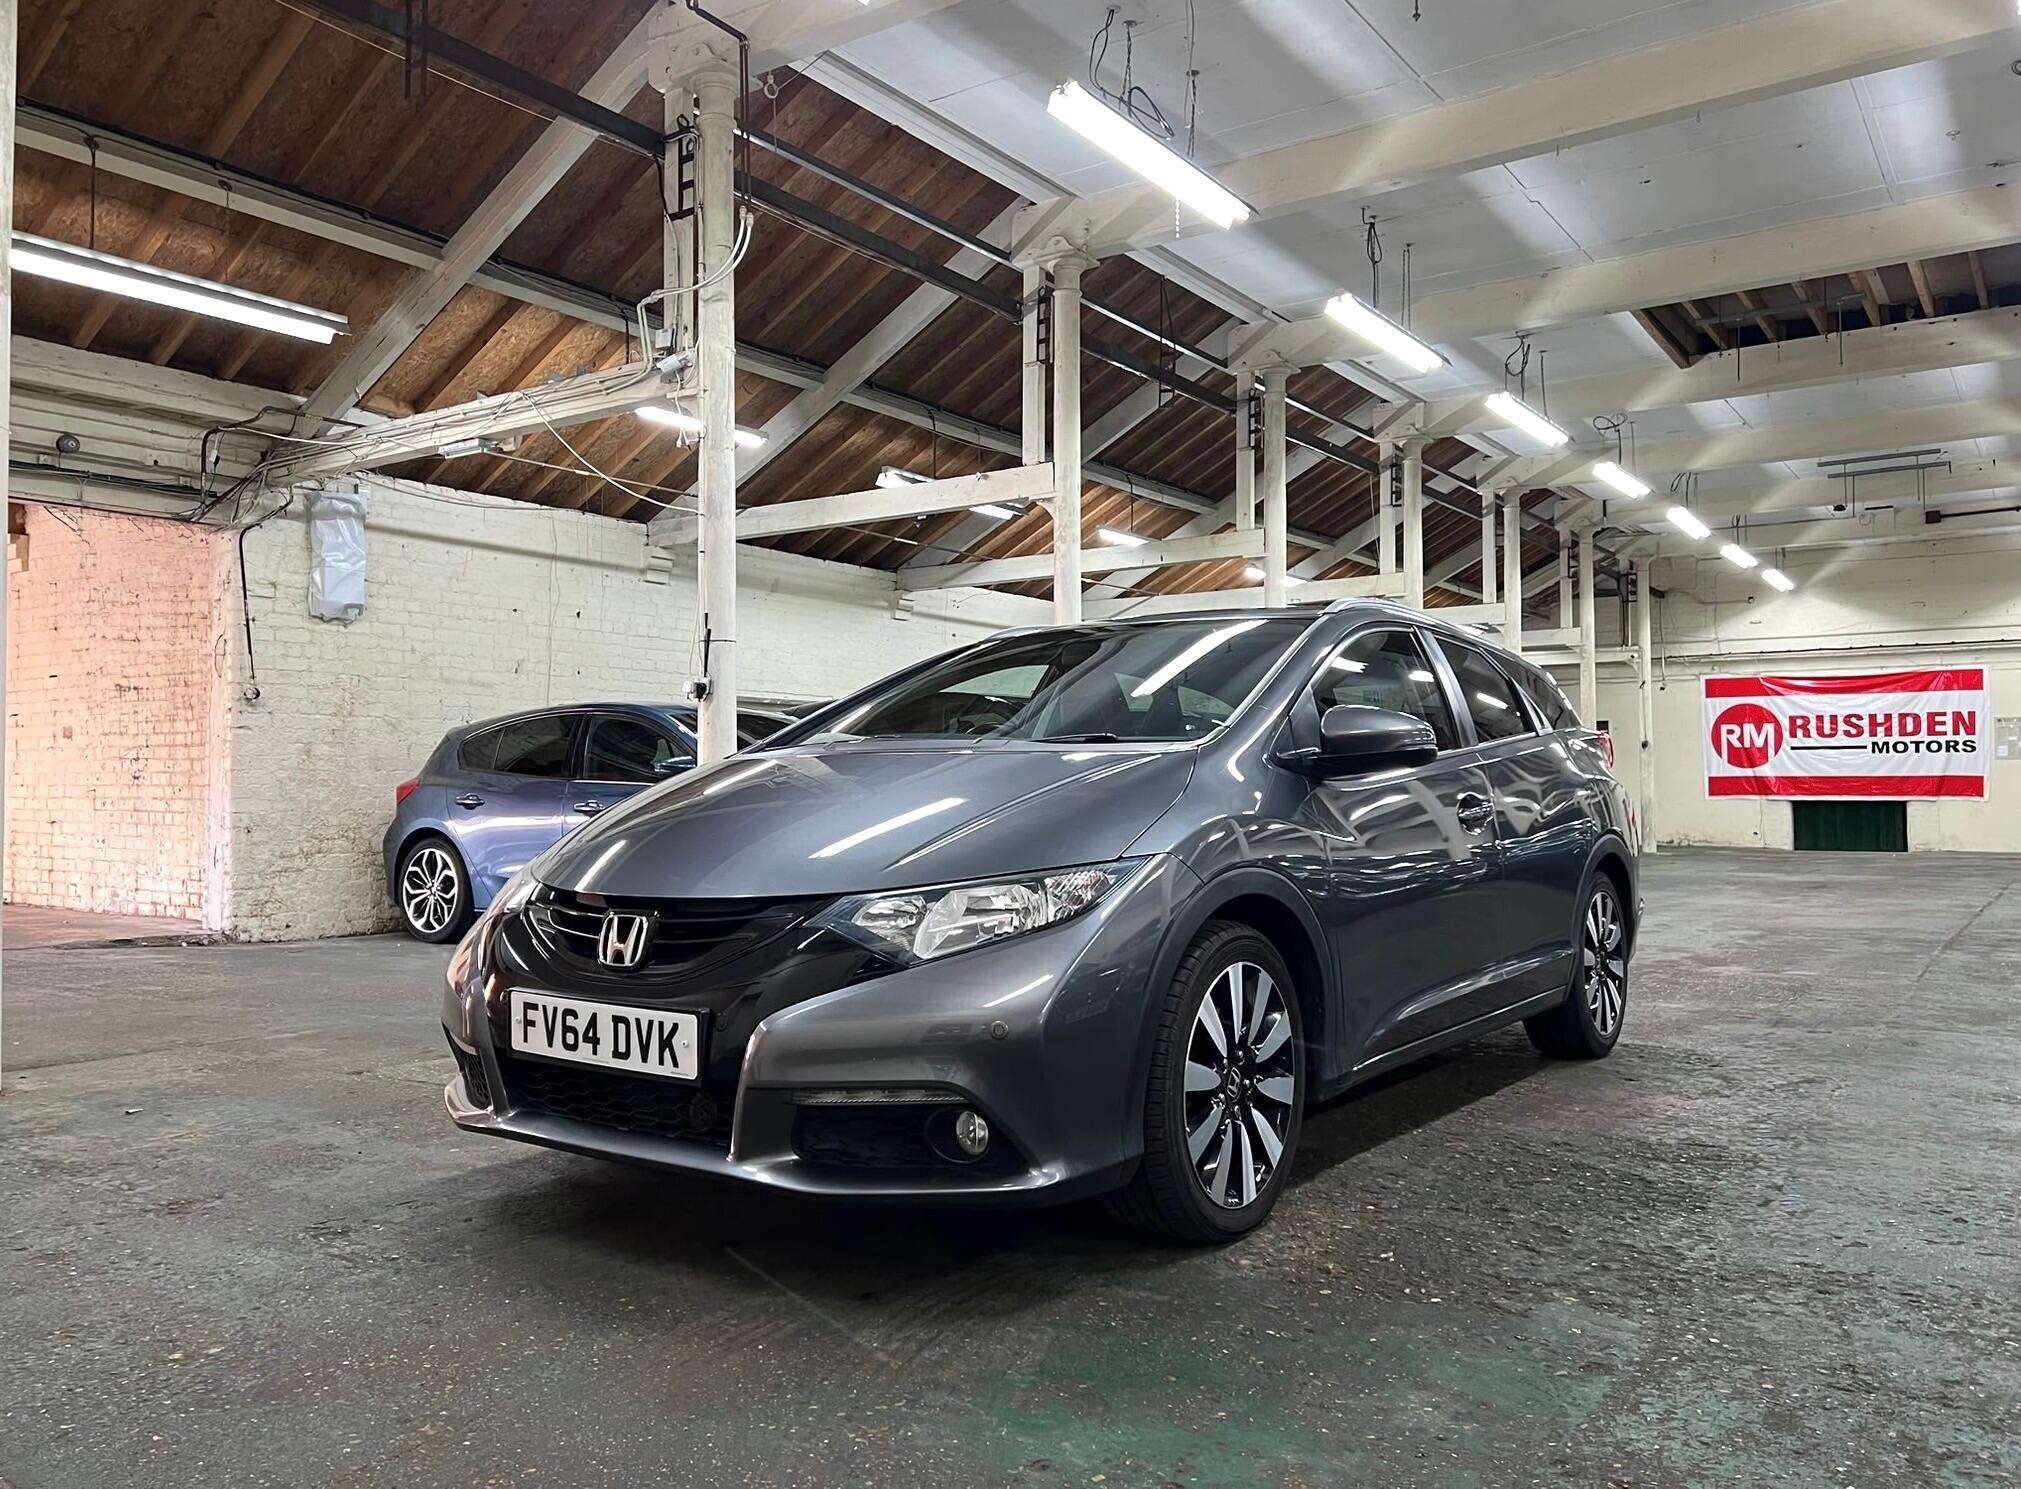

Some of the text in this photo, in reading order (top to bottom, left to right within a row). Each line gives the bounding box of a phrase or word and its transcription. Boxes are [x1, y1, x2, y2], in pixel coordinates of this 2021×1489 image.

[1720, 722, 1775, 759] RM
[1788, 711, 1976, 738] RUSHDEN
[1871, 740, 1977, 754] MOTORS
[522, 1001, 680, 1069] FV64 DVK
